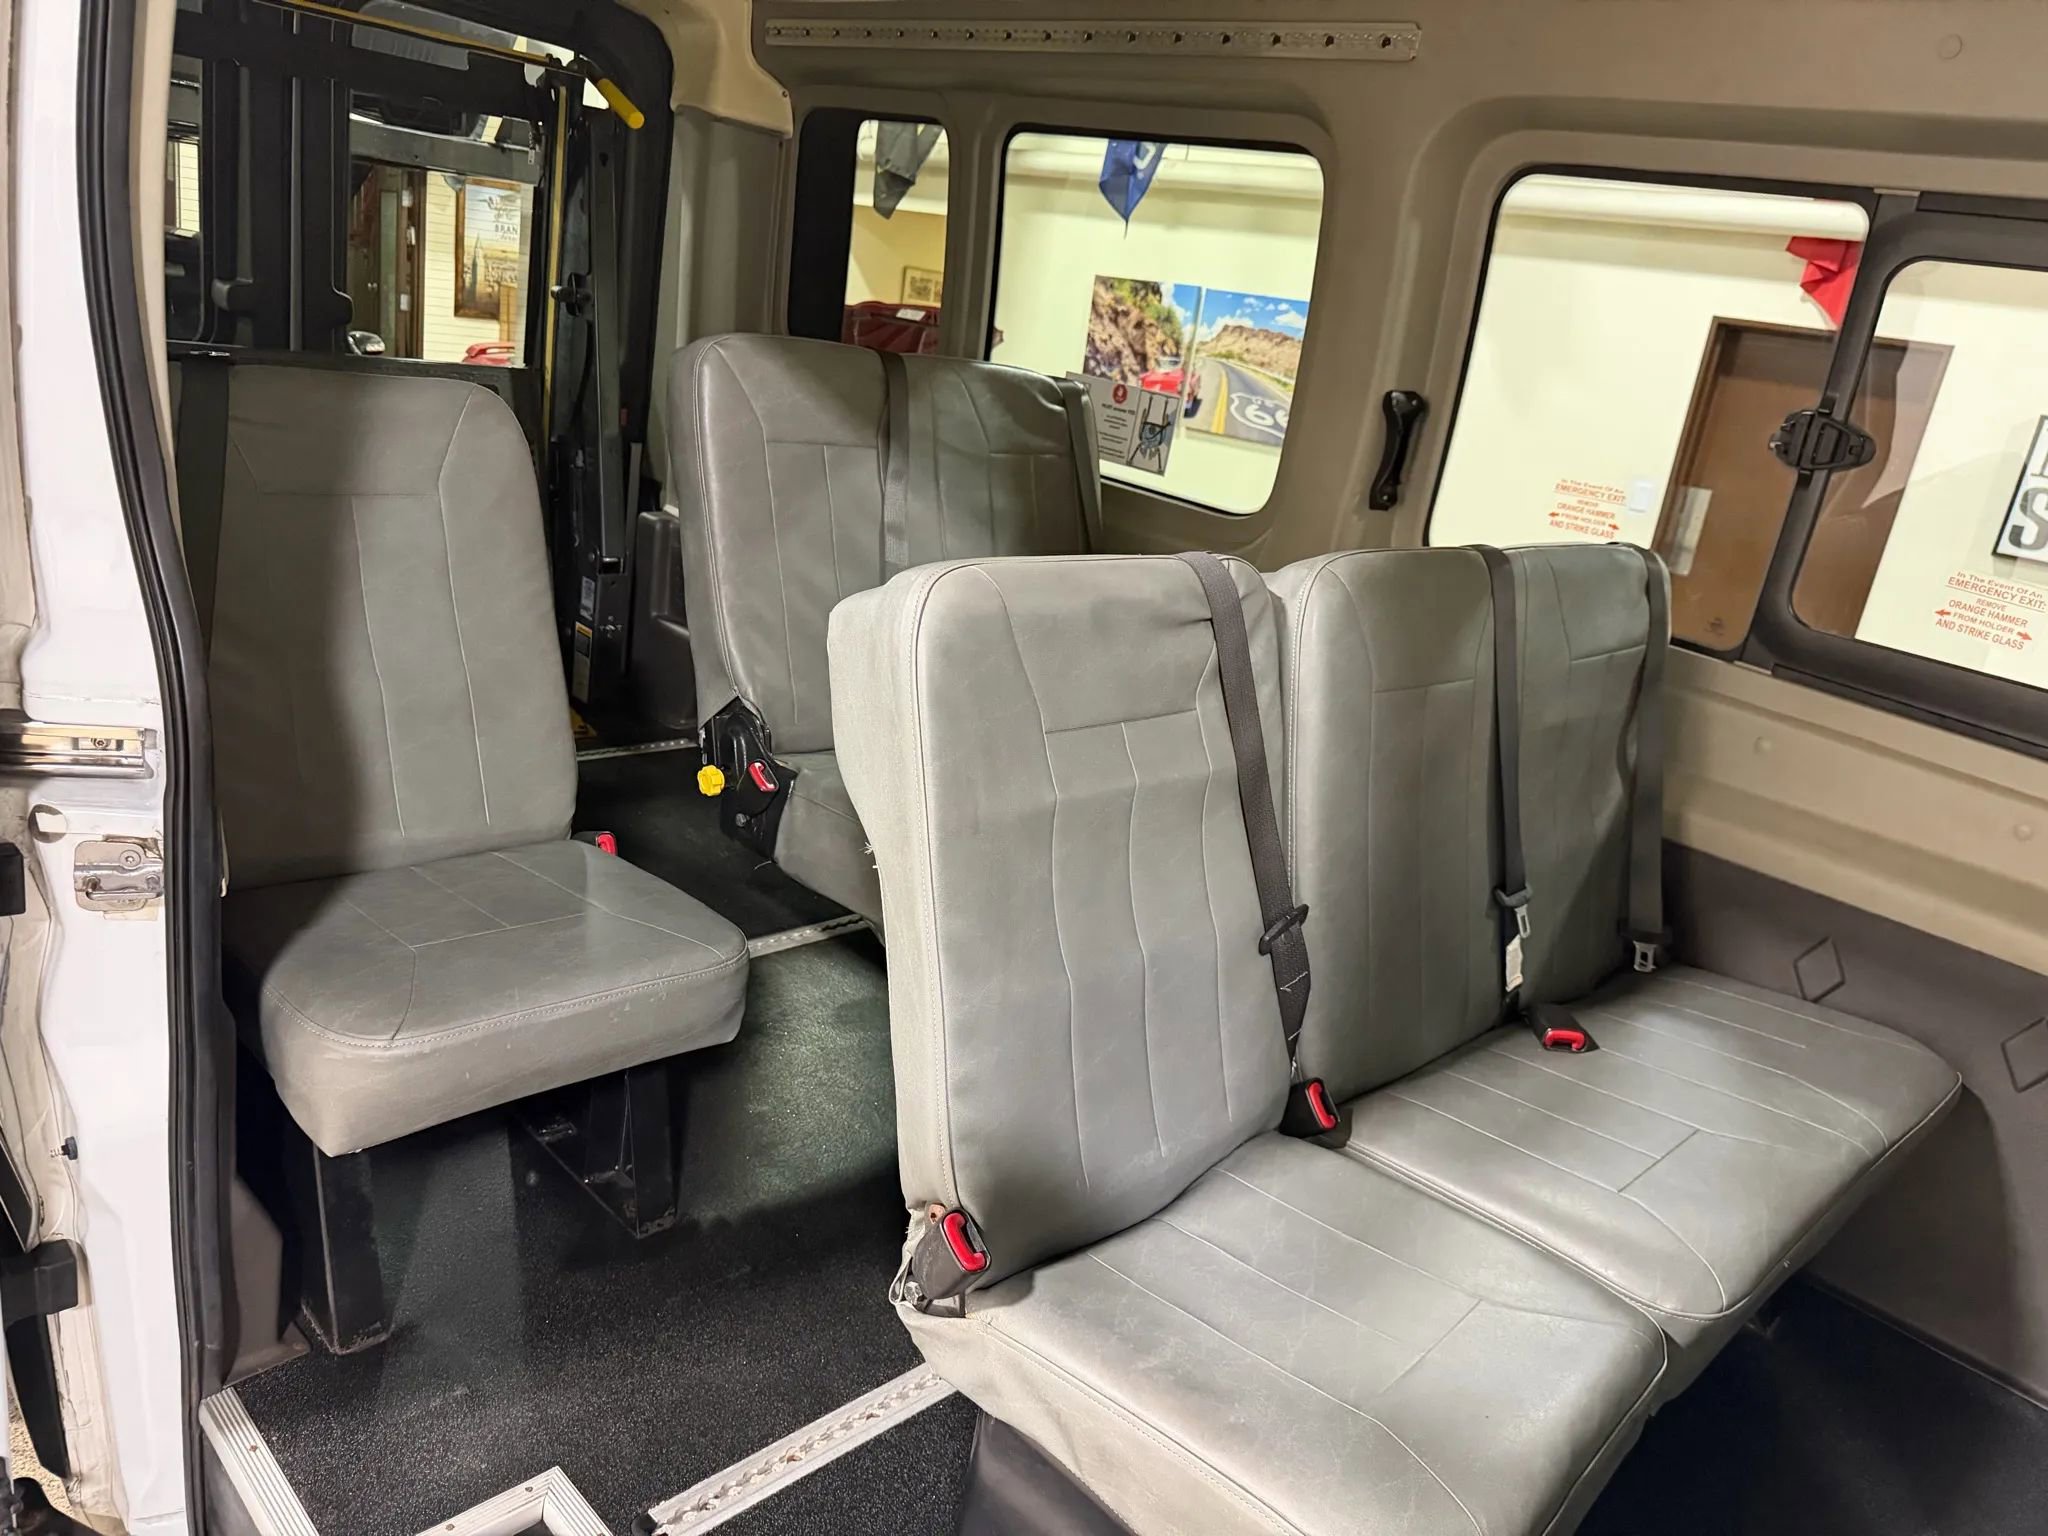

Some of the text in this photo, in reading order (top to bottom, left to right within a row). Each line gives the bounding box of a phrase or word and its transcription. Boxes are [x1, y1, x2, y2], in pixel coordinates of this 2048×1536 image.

[1556, 483, 1605, 498] EMERGENCY
[1557, 502, 1586, 514] ORANGE
[1550, 519, 1614, 539] AND STRIKE GLASS
[1948, 576, 2018, 601] EMERGENCY
[1957, 571, 2043, 599] In The Event Of An
[1948, 599, 2029, 628] ORANGE HAMMER
[1976, 598, 2008, 612] REMOVE
[1936, 618, 2025, 650] AND STRIKE GLASS
[1952, 612, 2016, 635] FROM HOLDER
